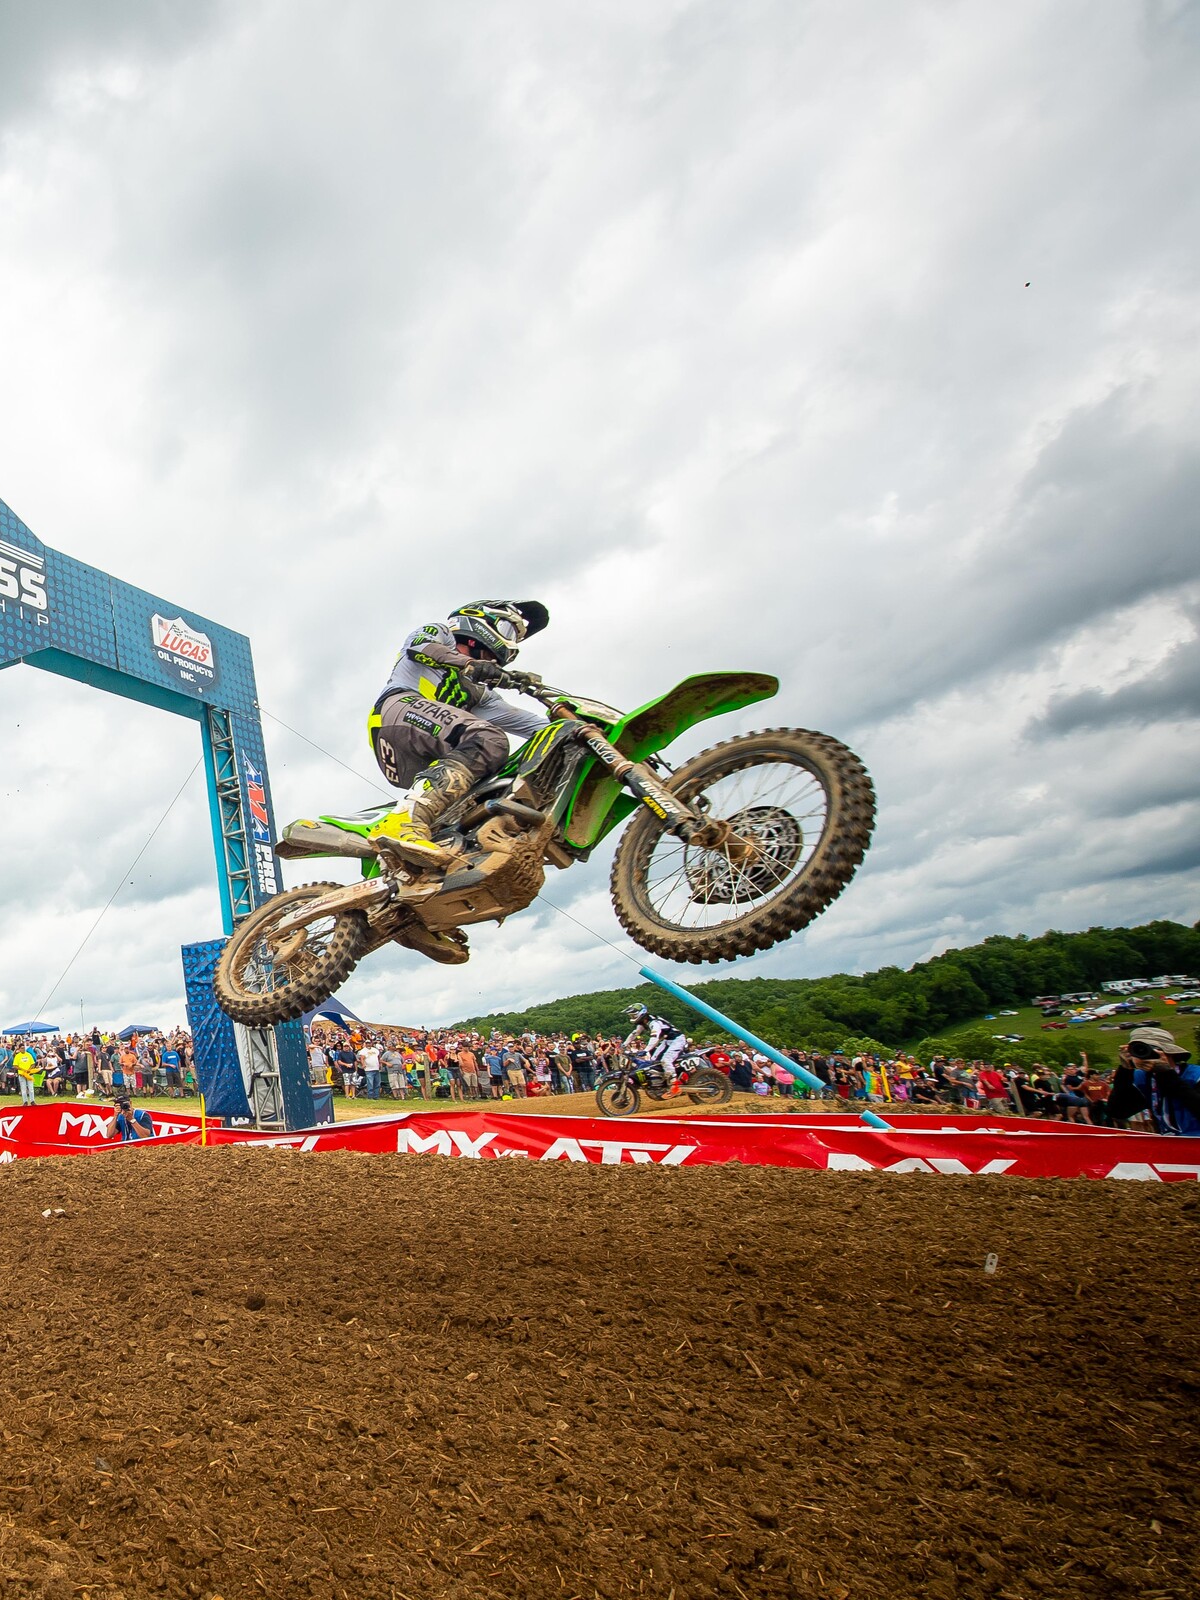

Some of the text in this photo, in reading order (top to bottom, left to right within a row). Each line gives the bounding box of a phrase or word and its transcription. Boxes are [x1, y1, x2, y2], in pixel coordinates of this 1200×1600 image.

[157, 650, 214, 678] OIL PRODUCTS
[160, 633, 209, 662] LUCAS
[241, 749, 270, 843] AMA
[261, 844, 277, 895] PRO
[58, 1112, 115, 1139] MX
[397, 1128, 499, 1159] MX
[540, 1138, 698, 1166] ATV
